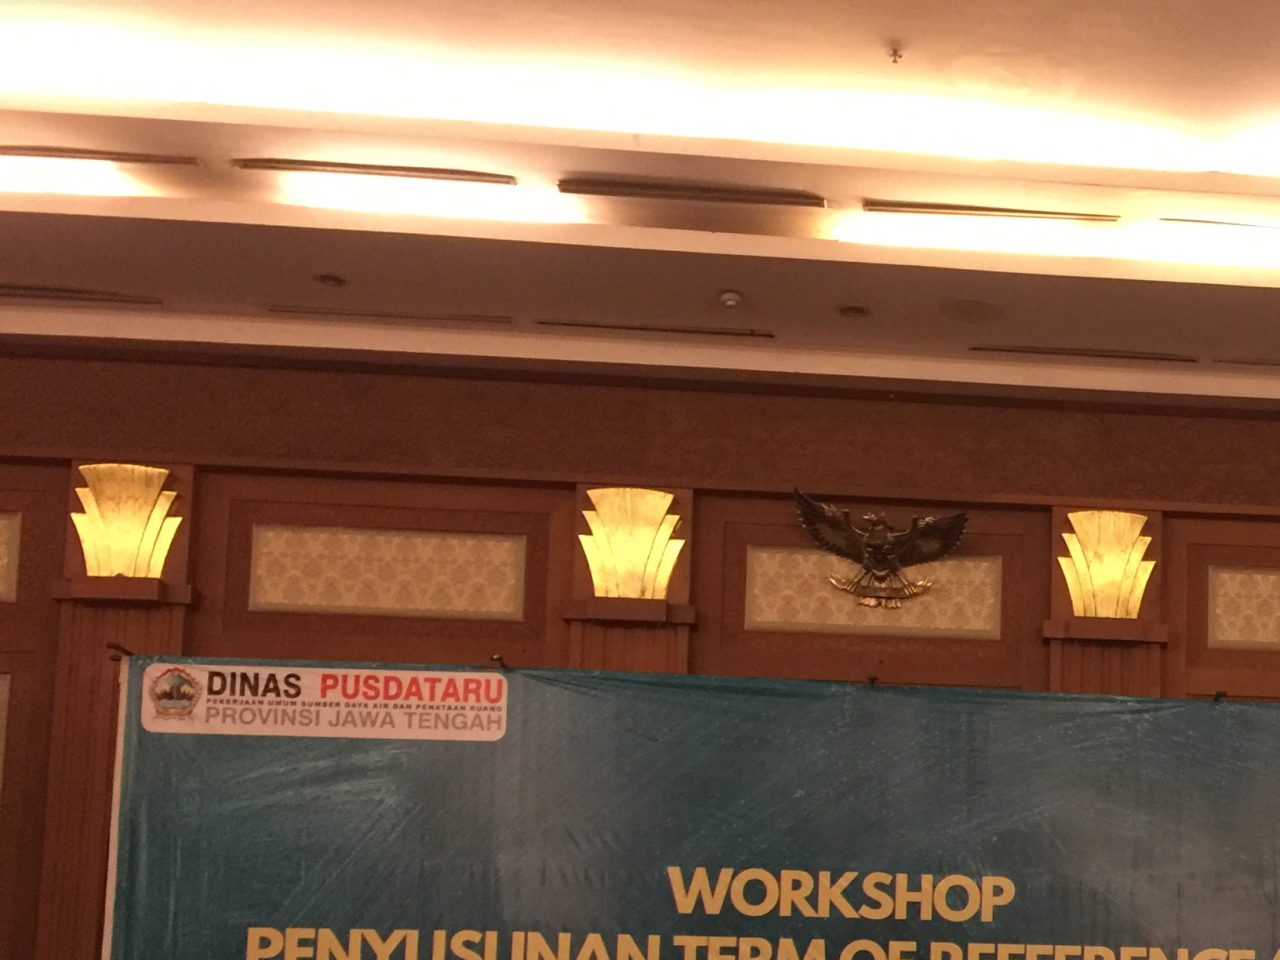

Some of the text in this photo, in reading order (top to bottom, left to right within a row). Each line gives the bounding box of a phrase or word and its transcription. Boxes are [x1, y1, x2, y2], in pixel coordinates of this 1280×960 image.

[206, 671, 503, 704] DINAS PUSDATARU
[205, 706, 503, 732] PROVINSI JAWA TENGAH
[373, 702, 389, 710] AIR
[469, 705, 503, 713] RUANG
[667, 866, 1015, 922] WORKSHOP
